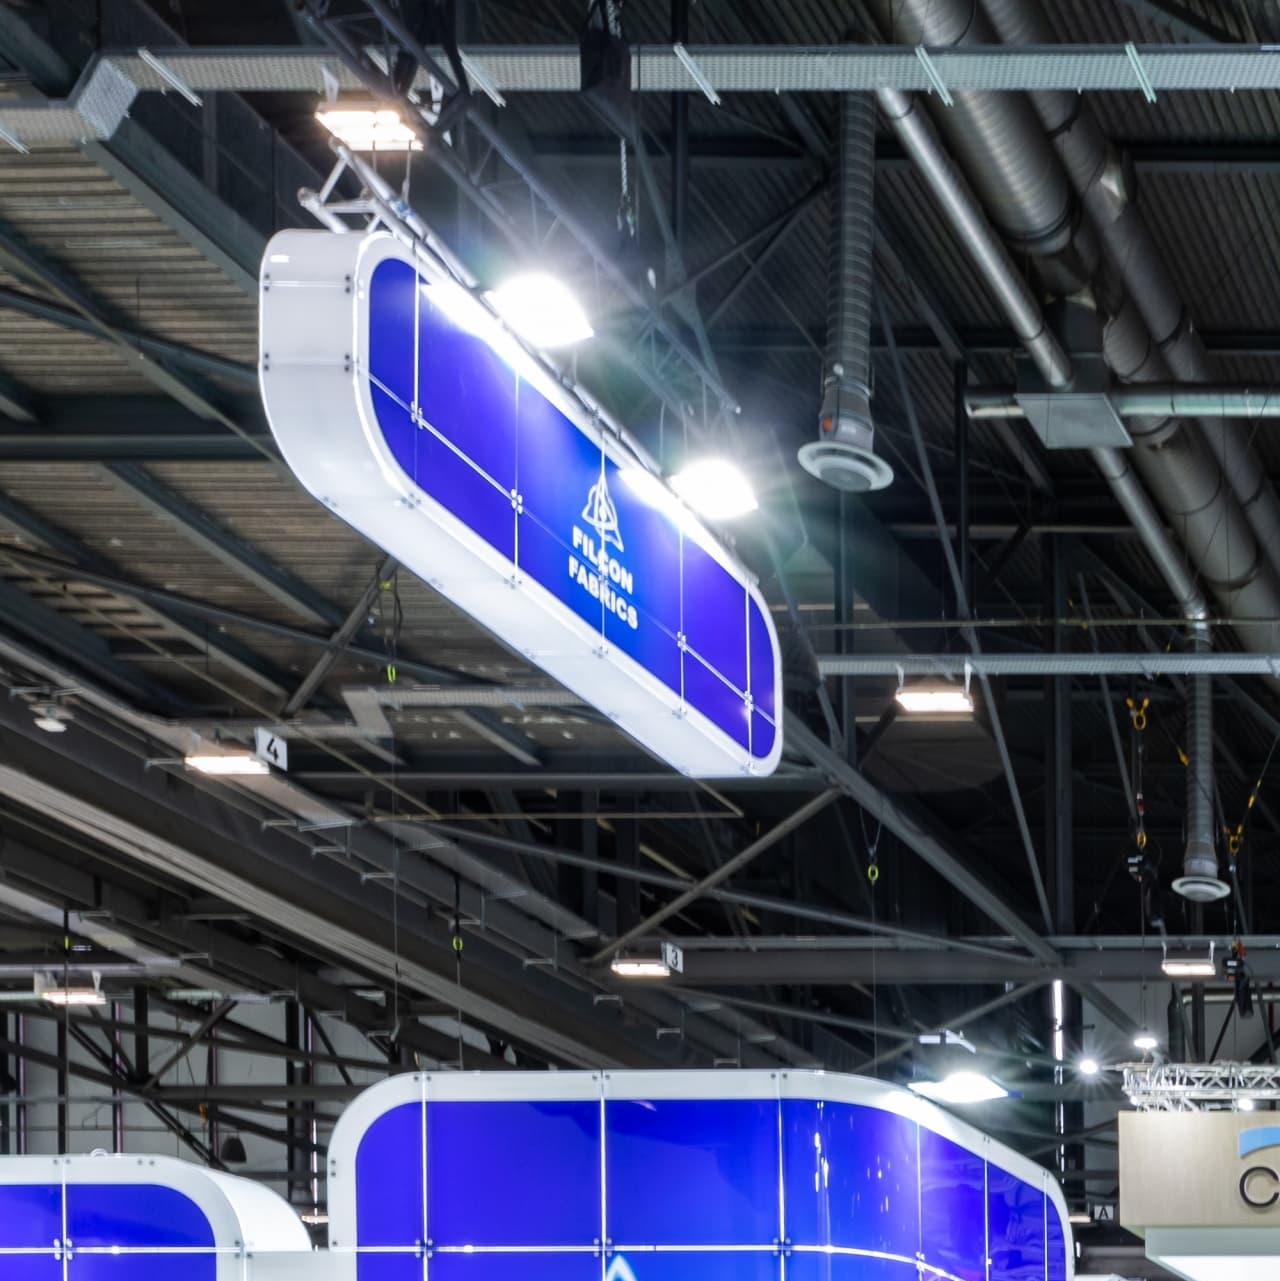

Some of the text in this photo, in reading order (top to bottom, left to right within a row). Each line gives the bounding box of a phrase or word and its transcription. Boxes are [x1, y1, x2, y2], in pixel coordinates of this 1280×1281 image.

[572, 525, 633, 595] FILCON
[568, 554, 638, 630] FABRICS
[266, 737, 279, 762] 4
[1098, 1206, 1110, 1220] A
